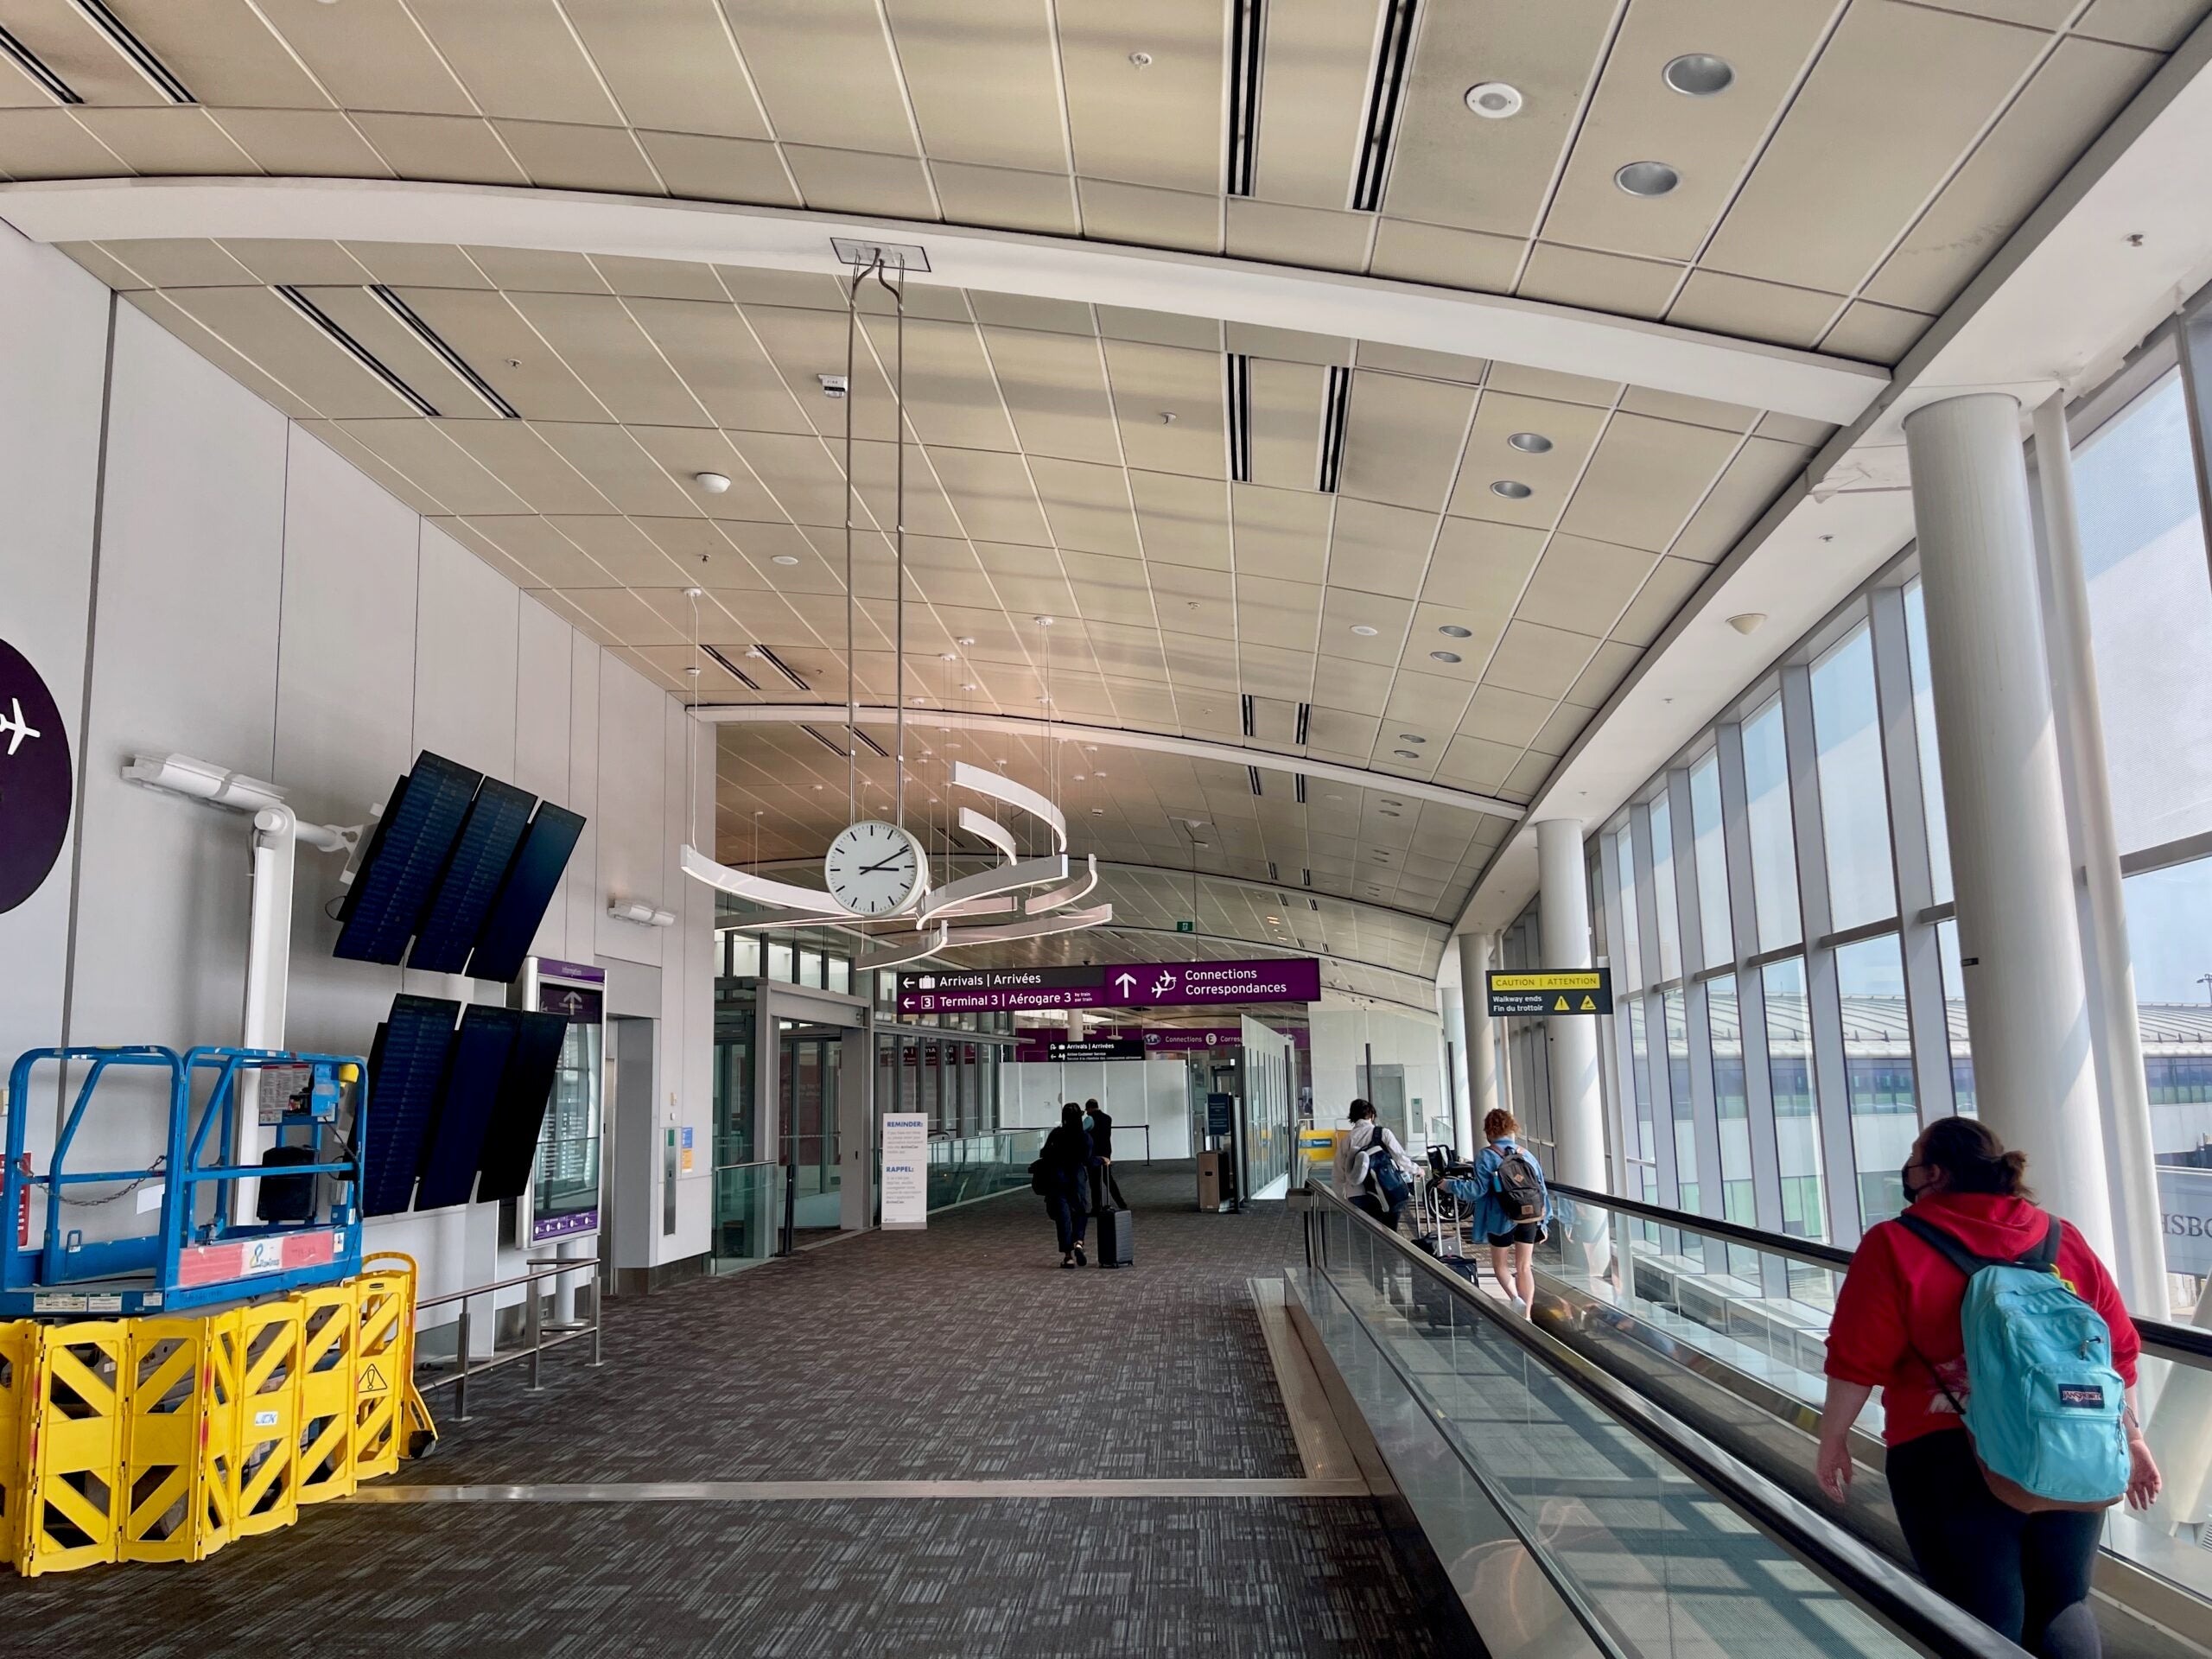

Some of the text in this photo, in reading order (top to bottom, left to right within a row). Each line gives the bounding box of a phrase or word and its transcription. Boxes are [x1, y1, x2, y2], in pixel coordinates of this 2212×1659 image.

[939, 973, 1041, 987] Arrivals Arrivées
[1185, 968, 1257, 981] Connections
[1495, 977, 1597, 987] CAUTION ATTENTION
[1185, 982, 1287, 996] Correspondances
[924, 992, 1071, 1007] 3 Terminal 3 Aérogare 3
[1492, 995, 1523, 1004] Walkway
